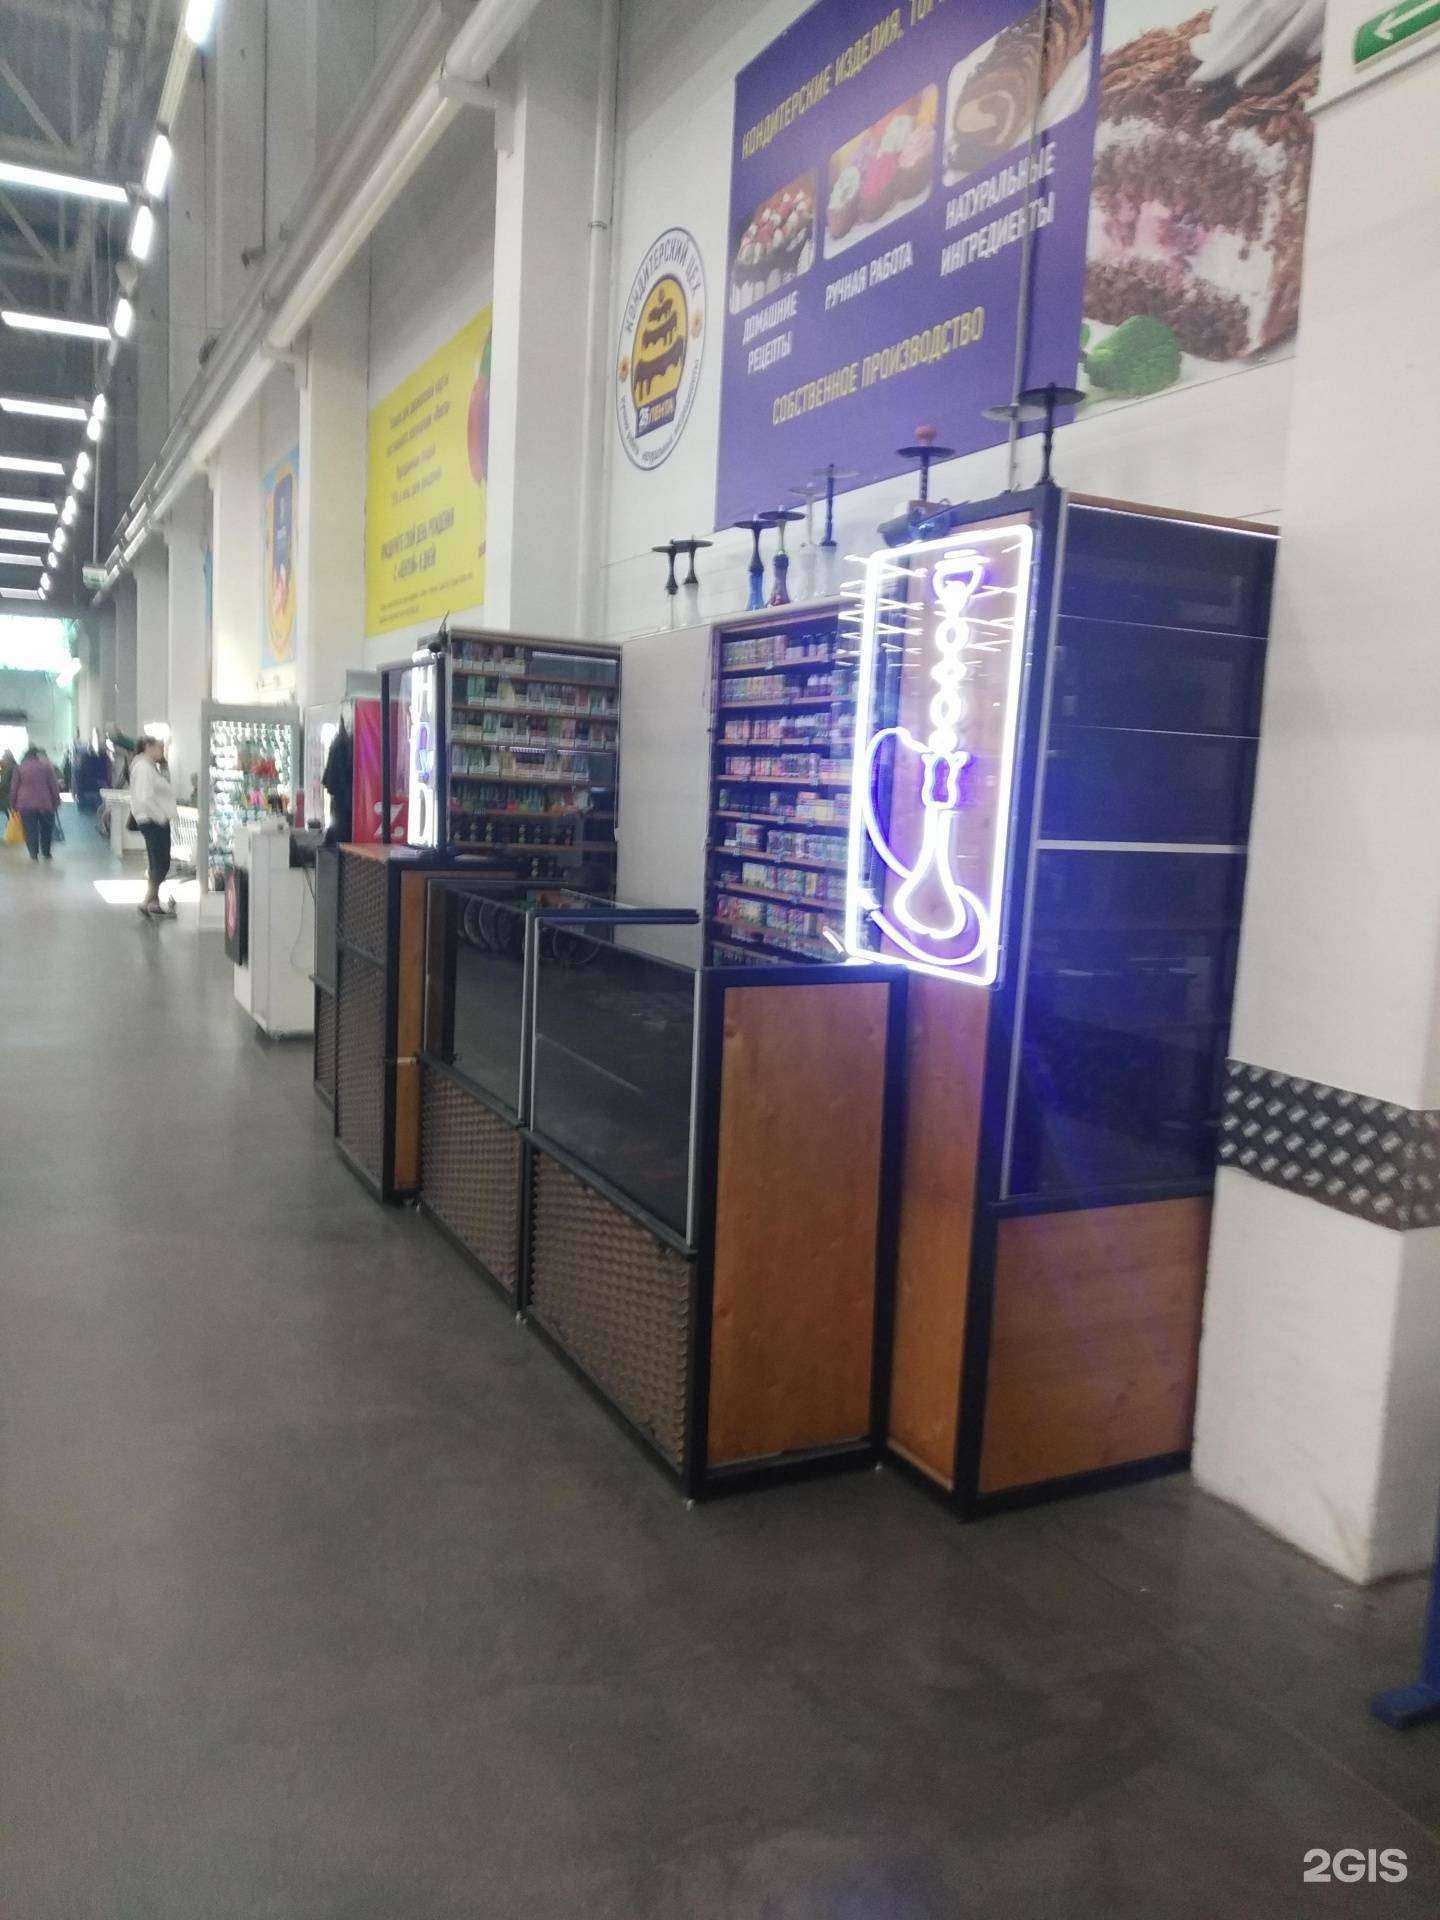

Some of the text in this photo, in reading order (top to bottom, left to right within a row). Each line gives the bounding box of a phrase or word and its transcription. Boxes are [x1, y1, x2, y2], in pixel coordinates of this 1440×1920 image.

[742, 63, 833, 160] КОНДИТЕРСКИЕ
[945, 141, 1056, 231] НАТУРАЛЬНЫЕ
[825, 240, 914, 312] РУЧНАЯ РАБОТА
[940, 191, 1056, 277] ИНГРЕДИЕНТЫ
[742, 290, 798, 346] ДОМАШНИЕ
[748, 331, 793, 375] РЕЦЕПТЫ
[772, 362, 858, 426] СОБСТВЕННОЕ
[861, 306, 985, 388] ПРОИЗВОДСТВО
